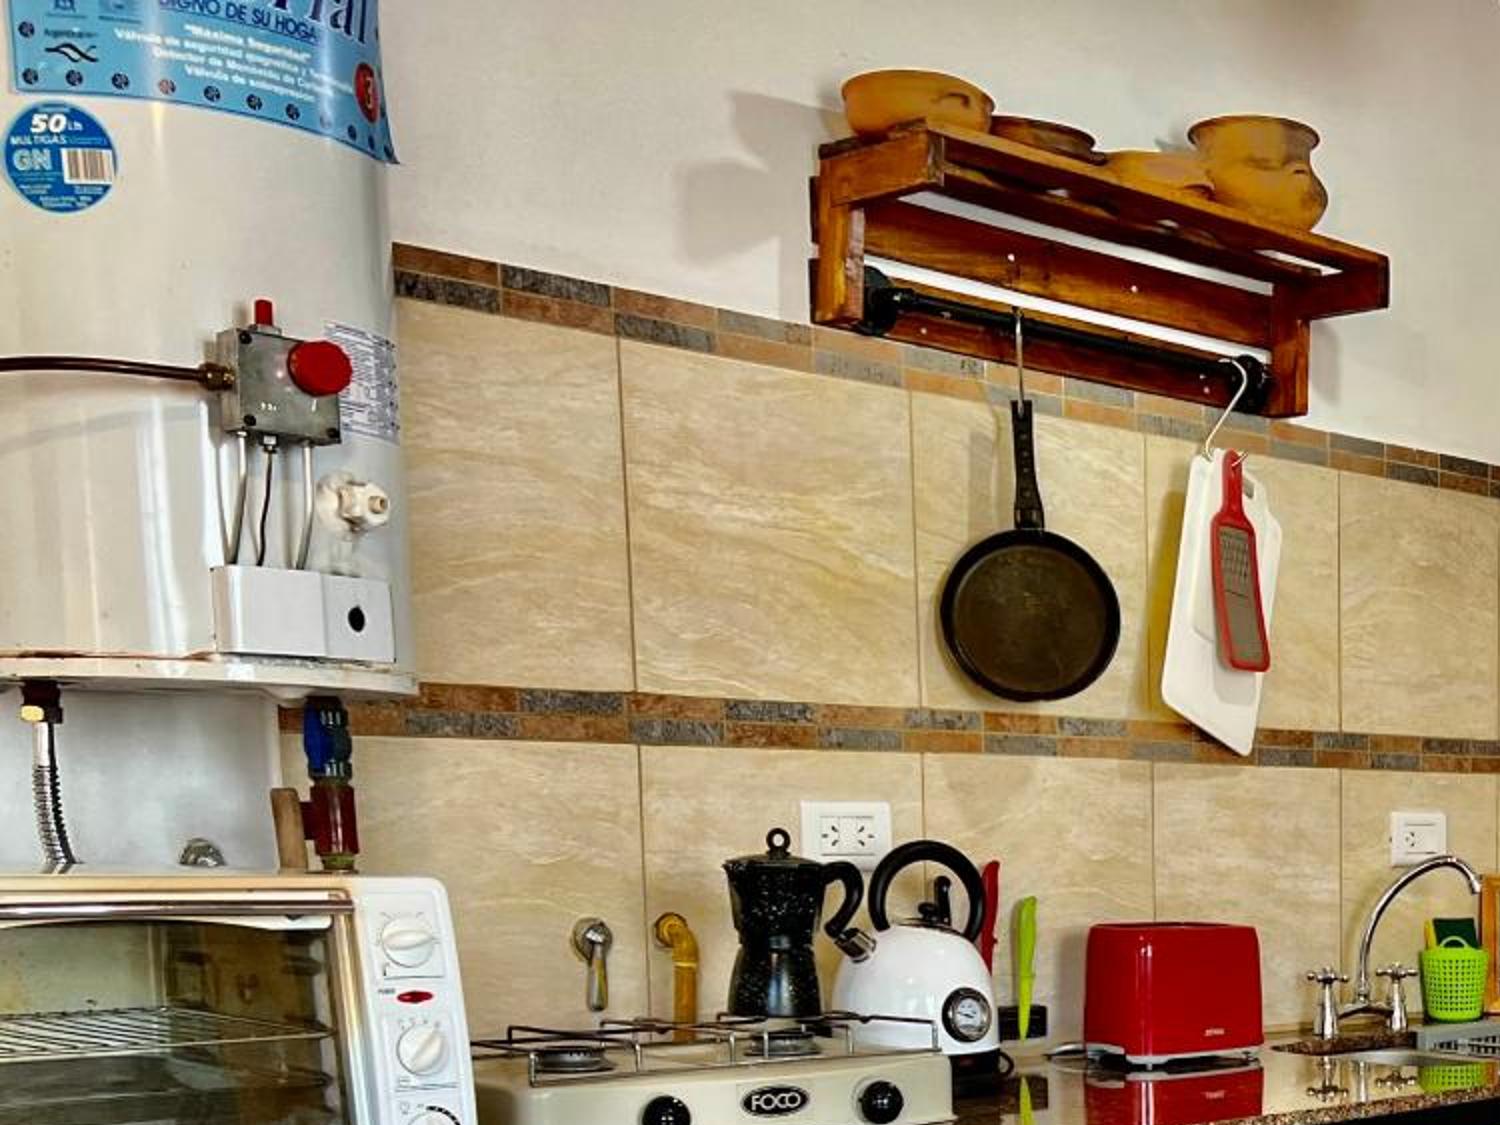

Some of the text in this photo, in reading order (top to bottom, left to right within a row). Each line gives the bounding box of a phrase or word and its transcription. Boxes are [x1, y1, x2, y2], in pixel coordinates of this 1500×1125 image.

[226, 2, 247, 21] DE
[252, 8, 271, 27] SU
[30, 113, 66, 133] 50
[10, 133, 67, 146] MULTIGAS
[13, 147, 53, 172] GN
[751, 1092, 801, 1111] FOCO
